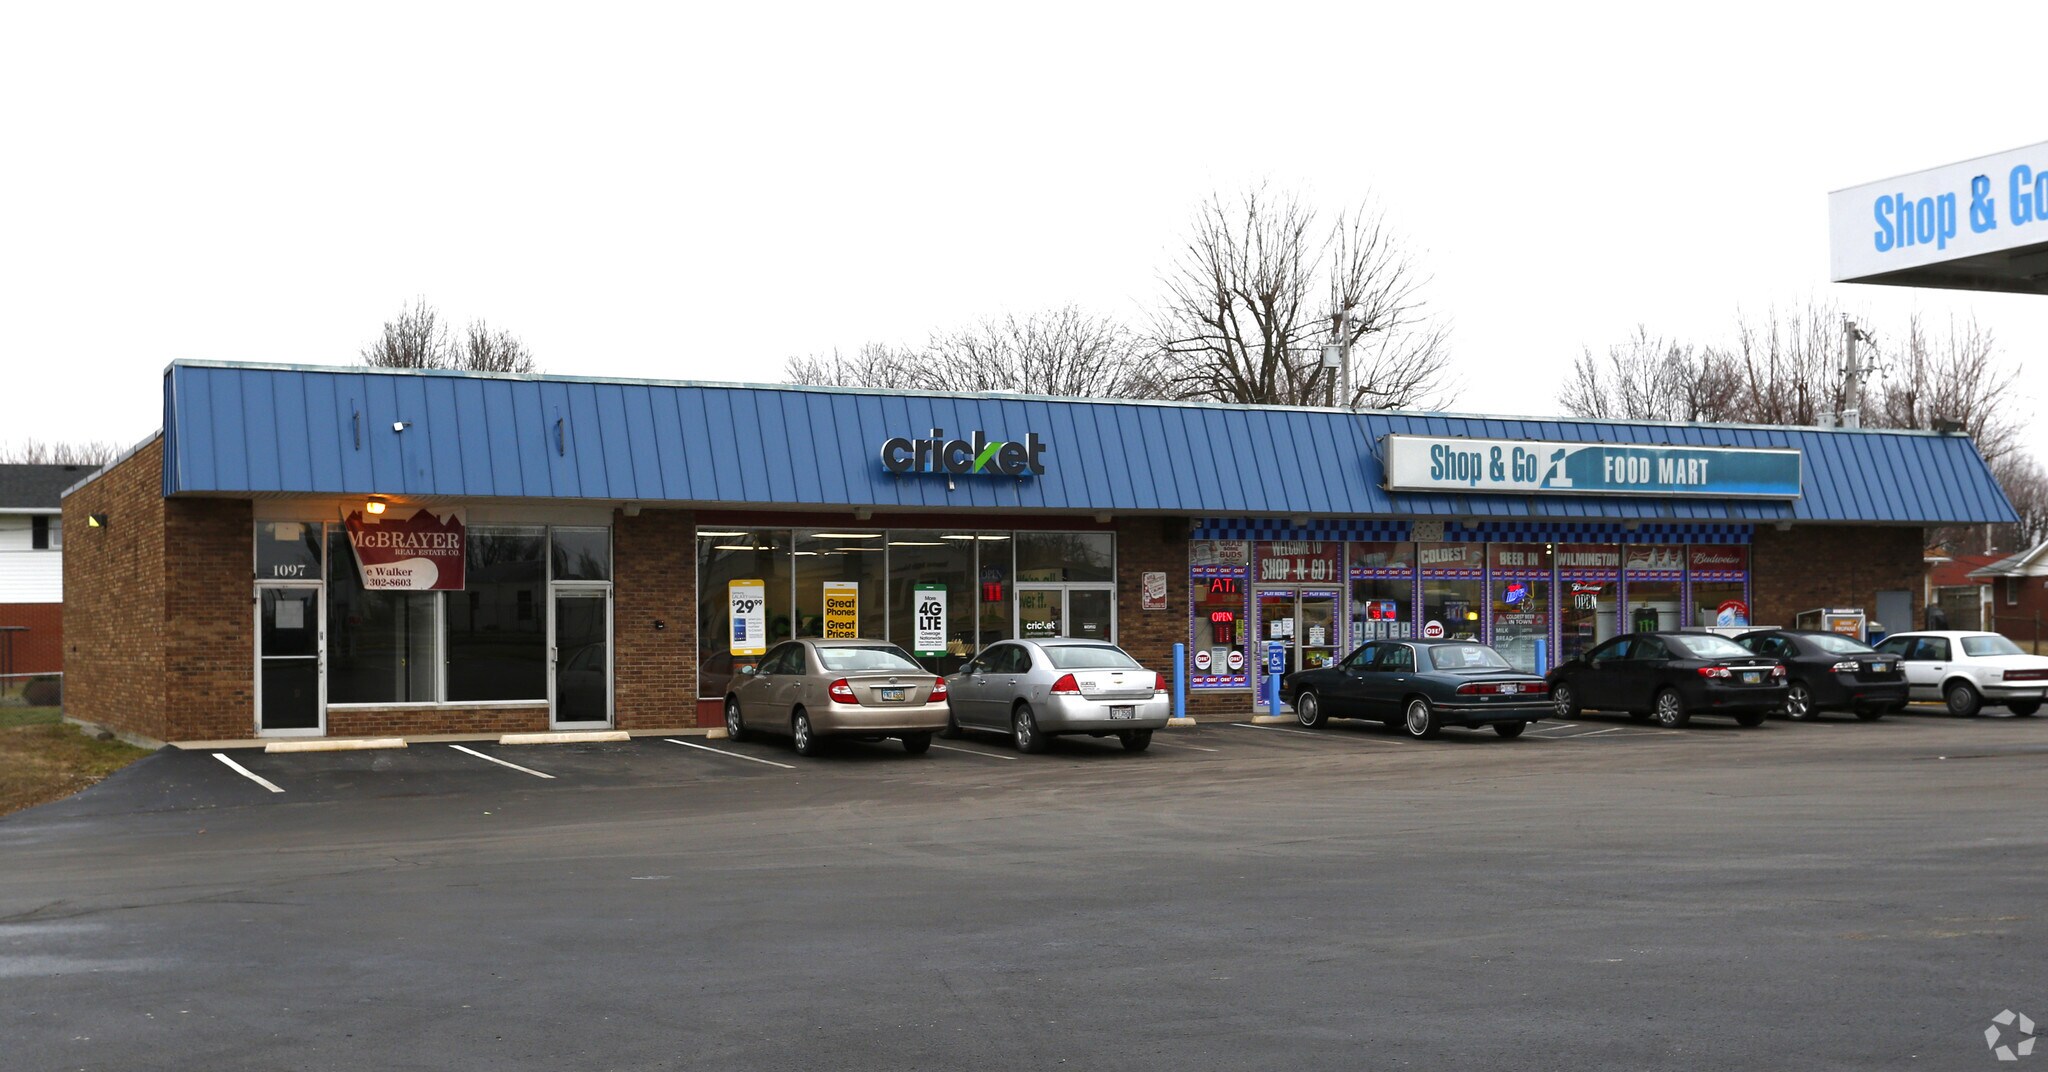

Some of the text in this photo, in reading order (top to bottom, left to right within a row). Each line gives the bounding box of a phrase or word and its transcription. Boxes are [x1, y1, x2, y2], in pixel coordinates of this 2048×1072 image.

[1874, 164, 2048, 252] Shop & Go
[881, 428, 1046, 475] cricket
[1430, 444, 1709, 487] Shop & Go 1 FOOD MART
[348, 531, 460, 549] McBRAYER
[1272, 541, 1310, 556] WELCOME
[1421, 546, 1467, 564] COLDEST
[1500, 552, 1539, 566] BEER IN
[1558, 553, 1619, 566] WILMINGTON
[274, 564, 306, 577] 1097
[376, 568, 413, 577] Walker
[1262, 559, 1290, 580] SHOP
[1311, 559, 1325, 580] GO
[370, 579, 412, 587] 302-8603
[827, 598, 855, 608] Great
[919, 602, 942, 616] 4G
[1574, 594, 1597, 610] OPEN
[827, 608, 855, 616] Phones
[1212, 612, 1233, 622] OPEN
[827, 620, 855, 629] Great
[920, 616, 941, 630] LTE
[1026, 621, 1055, 630] cricket
[827, 630, 855, 638] Prices
